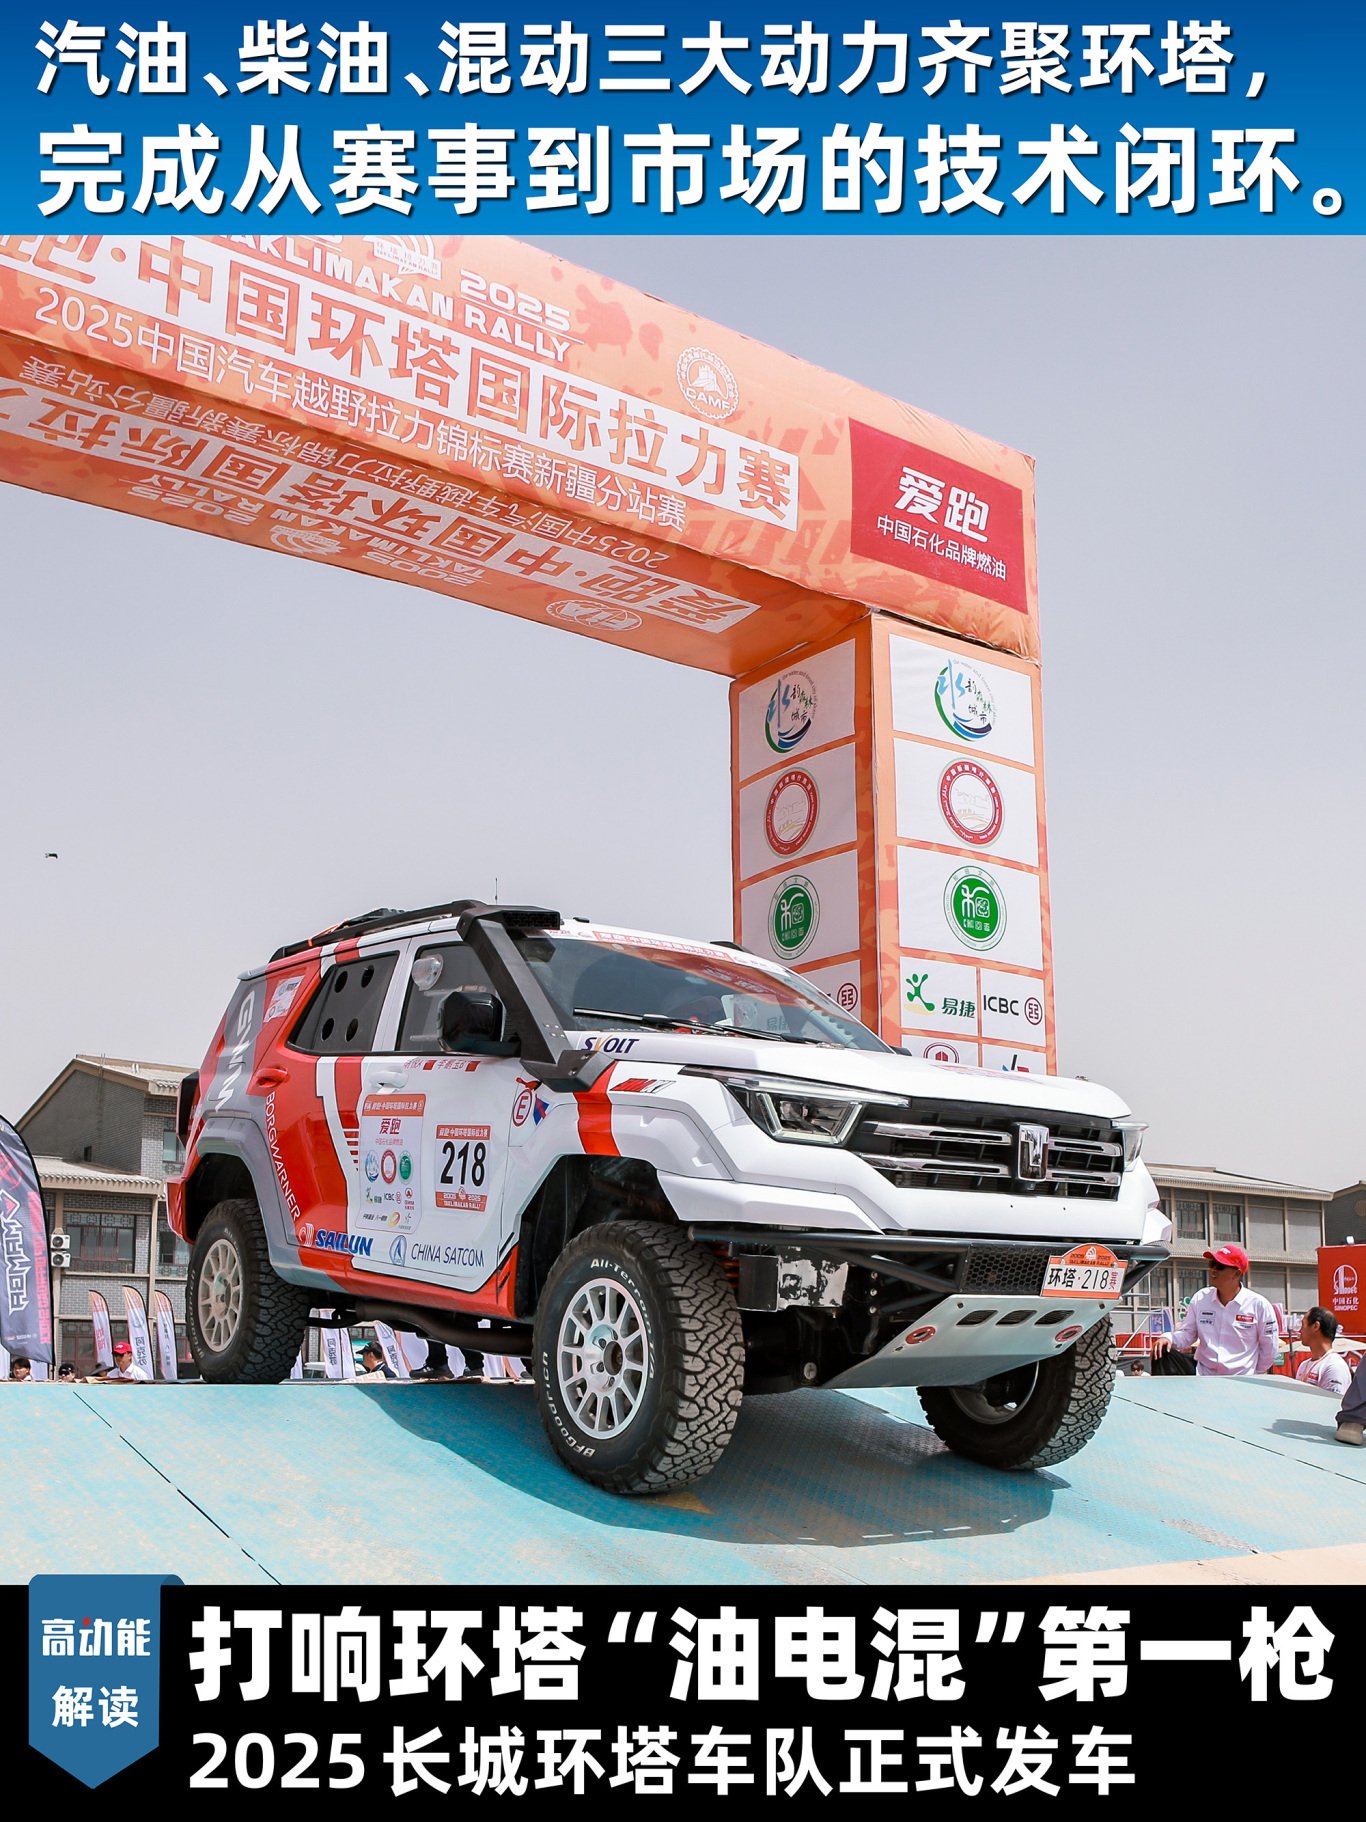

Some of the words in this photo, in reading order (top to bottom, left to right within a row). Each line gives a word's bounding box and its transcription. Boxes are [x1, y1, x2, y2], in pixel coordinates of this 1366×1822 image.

[221, 235, 453, 320] AKLIMAKAN
[465, 310, 572, 363] RALLY
[460, 269, 572, 332] 2025
[35, 287, 687, 532] 2025中国汽车越野拉力锦标赛新疆分站赛
[686, 387, 730, 410] CAMF
[0, 387, 751, 626] 爱跑·中国环塔国际拉
[895, 467, 990, 543] 爱跑
[877, 515, 1007, 581] 中国石化品牌燃油
[941, 998, 976, 1018] 易捷
[983, 995, 1020, 1016] ICBC
[581, 1037, 640, 1054] SVOLT
[266, 1091, 301, 1221] BORGWARNER
[440, 1141, 486, 1187] 218
[316, 1230, 373, 1257] SAILUN
[411, 1243, 441, 1262] CHINA
[445, 1246, 485, 1268] SATCOM
[542, 1351, 596, 1458] BFGoodrich
